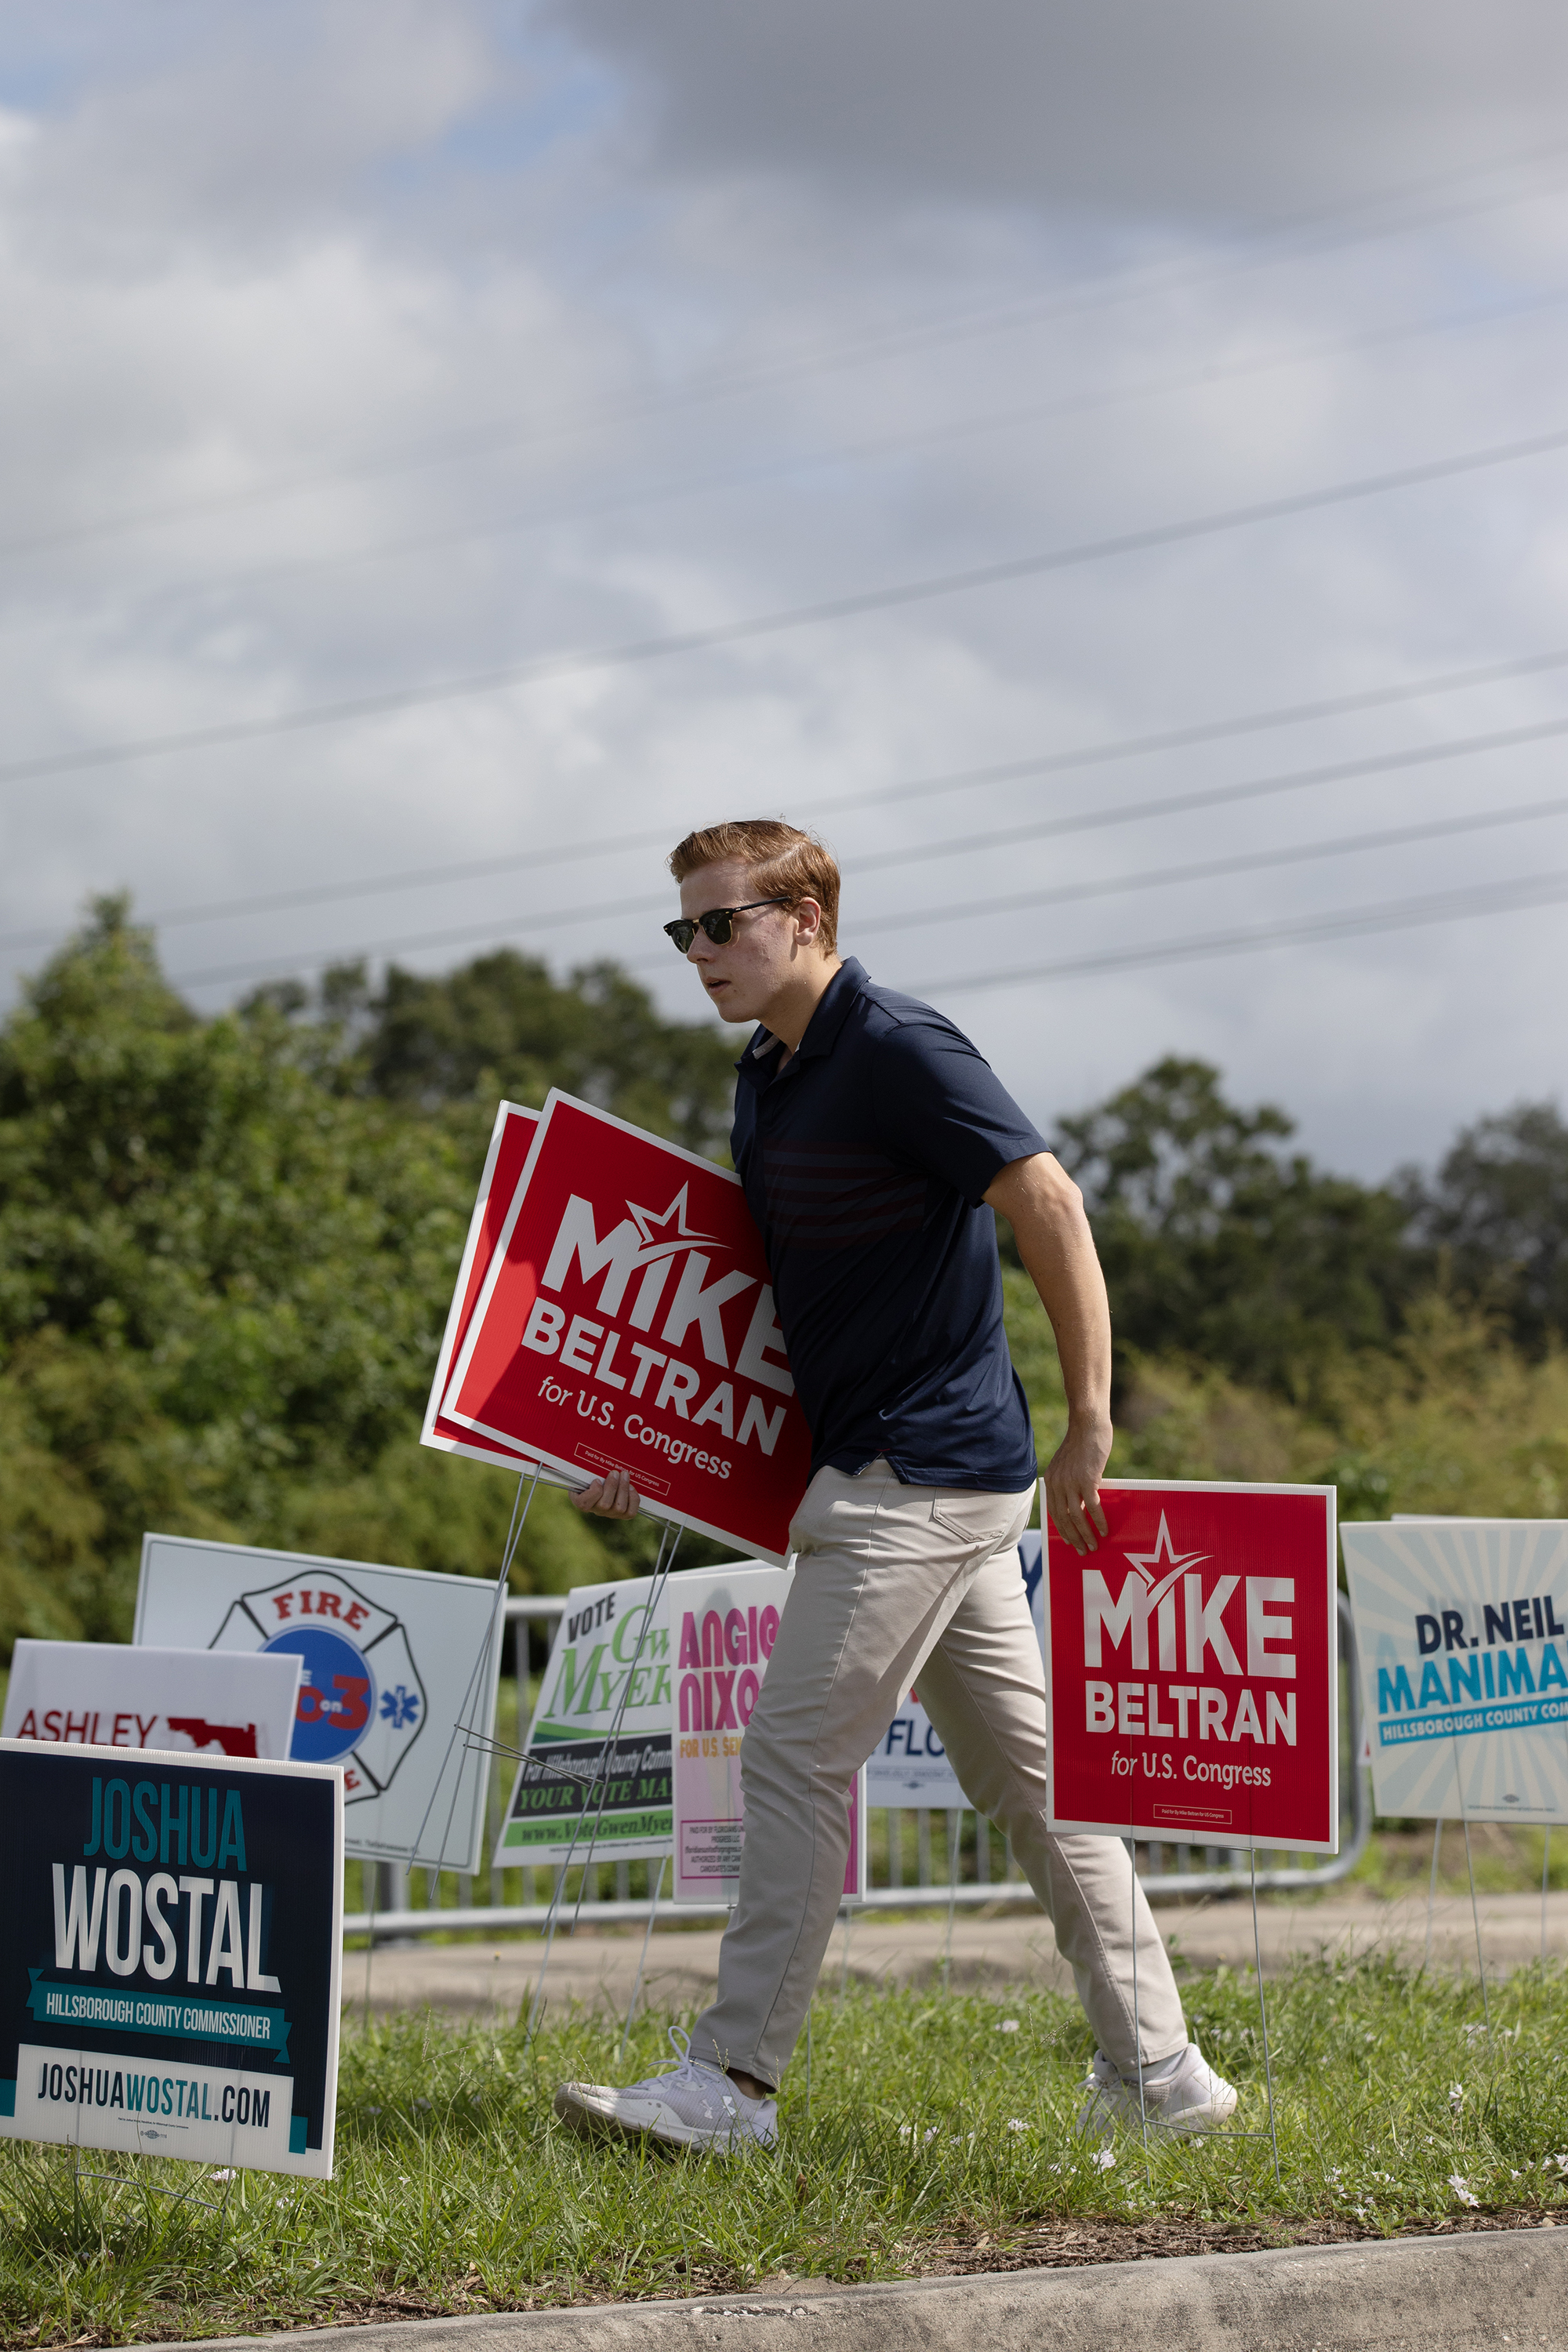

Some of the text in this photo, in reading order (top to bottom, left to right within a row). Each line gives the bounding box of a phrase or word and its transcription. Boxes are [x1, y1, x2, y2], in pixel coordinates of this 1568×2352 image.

[540, 1193, 795, 1397] MIKE
[521, 1297, 787, 1457] BELTRAN
[537, 1376, 732, 1479] for U.S. Congress
[605, 1459, 615, 1468] Mike
[641, 1475, 659, 1487] Congress
[272, 1590, 371, 1632] FIRE
[568, 1592, 616, 1644] VOTE
[678, 1604, 780, 1670] ANGIE
[1082, 1569, 1297, 1679] MIKE
[1415, 1595, 1564, 1655] DR. NEIL
[319, 1699, 343, 1713] on
[327, 1673, 369, 1730] 3
[679, 1668, 761, 1733] NIXO
[1377, 1642, 1568, 1715] MANIMA
[16, 1708, 158, 1748] ASHLEY
[1085, 1680, 1297, 1747] BELTRAN
[1382, 1712, 1484, 1741] HILLSBOROUGH
[1486, 1704, 1538, 1726] COUNTY
[680, 1738, 699, 1759] FOR
[1111, 1750, 1272, 1791] for U.S. Congress
[520, 1777, 672, 1810] YOUR VOTE MA
[83, 1777, 247, 1871] JOSHUA
[52, 1863, 281, 1993] WOSTAL
[46, 1992, 270, 2039] HILLSBOROUGH COUNTY COMMISSIONER
[38, 2062, 270, 2128] JOSHUAWOSTAL.COM
